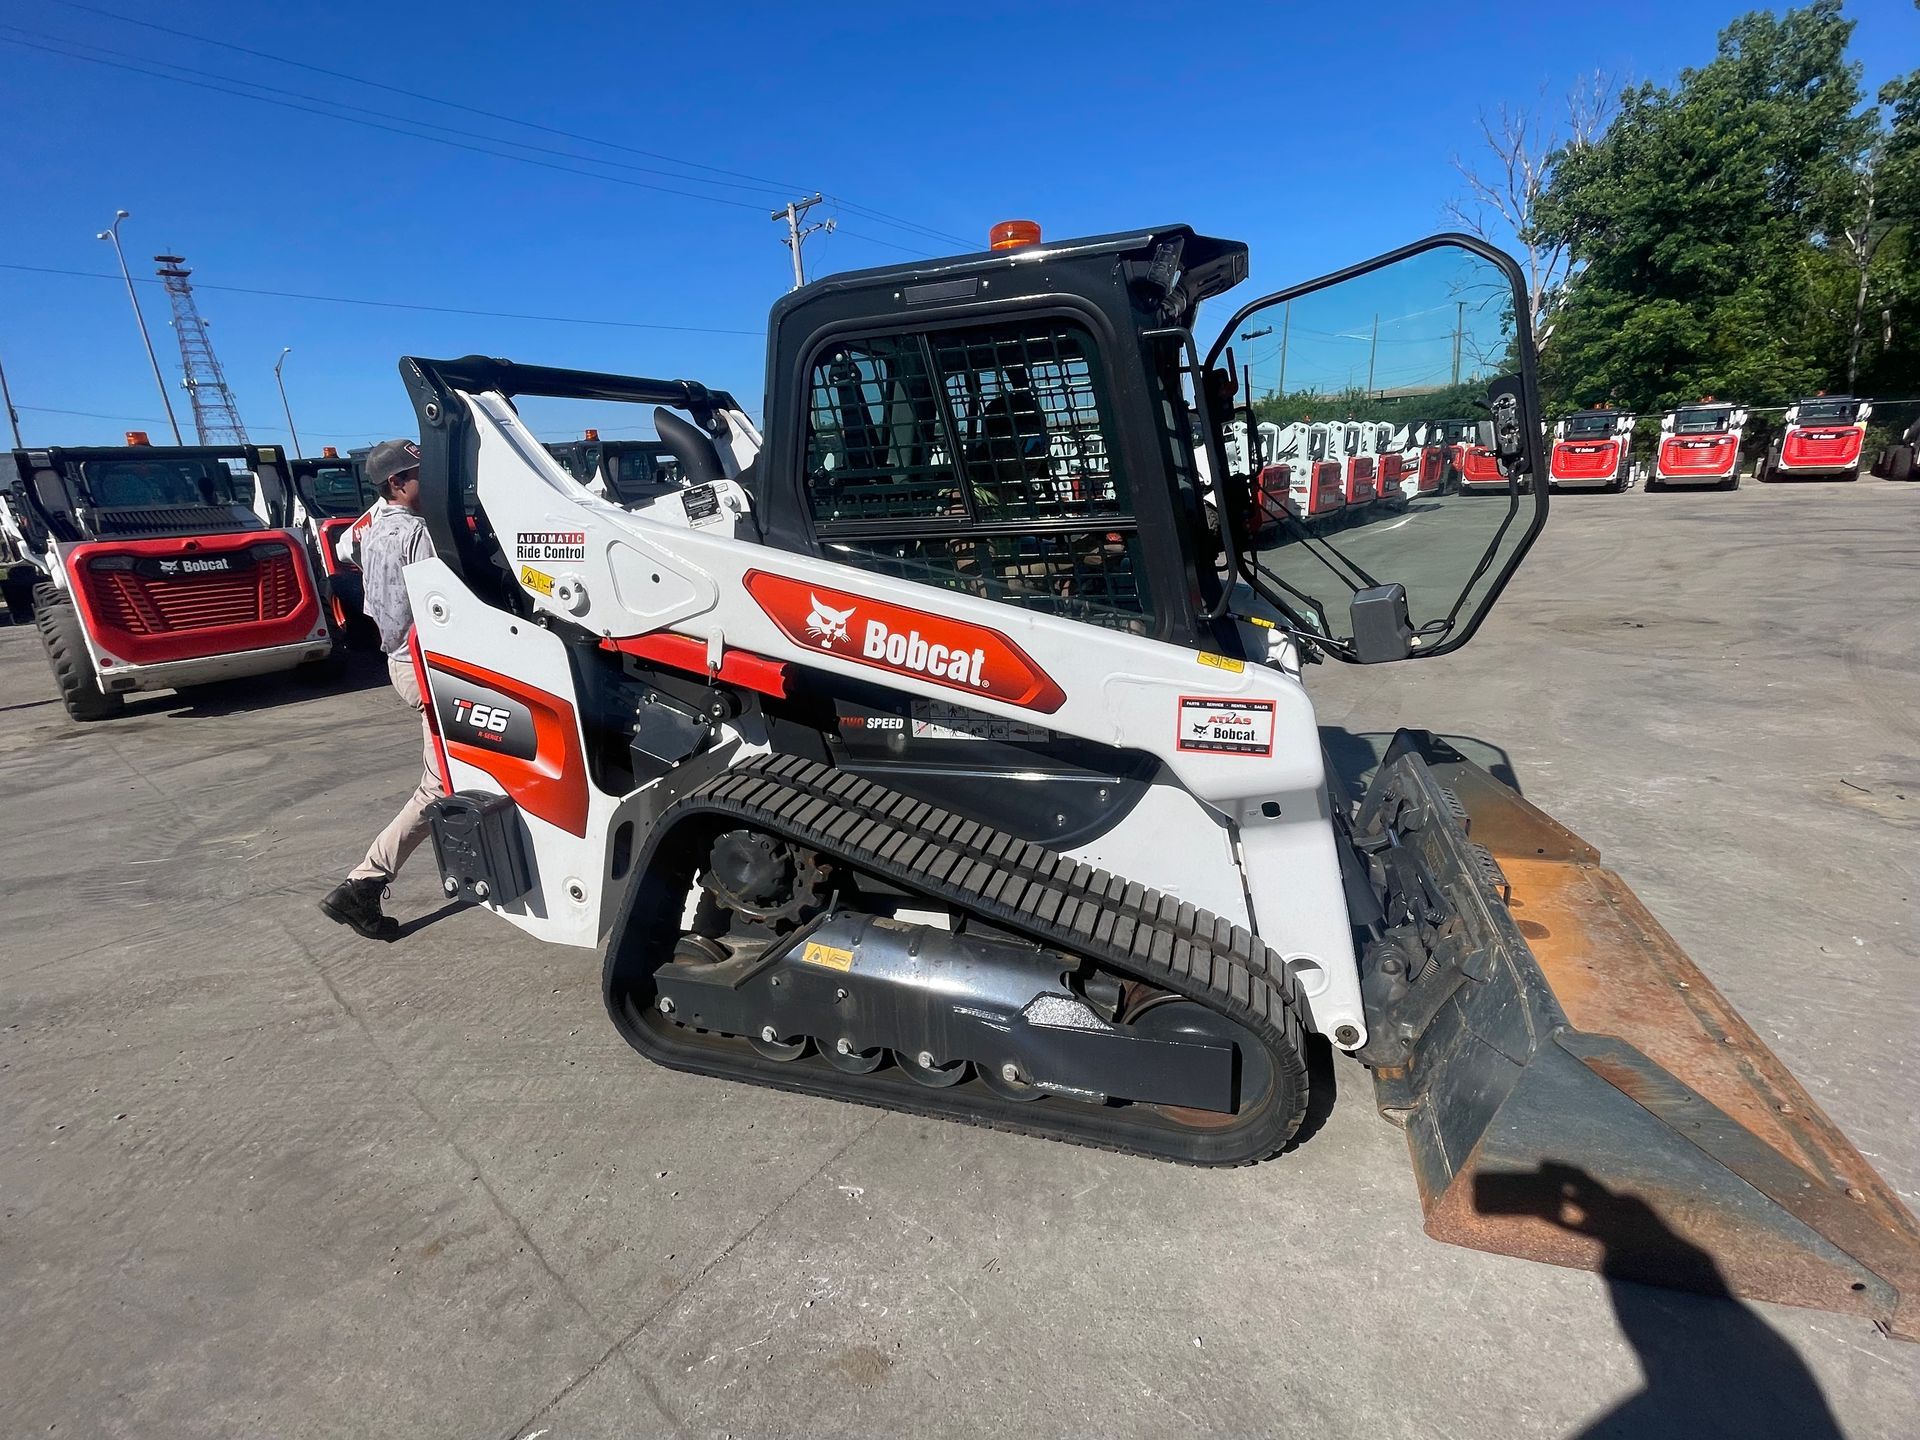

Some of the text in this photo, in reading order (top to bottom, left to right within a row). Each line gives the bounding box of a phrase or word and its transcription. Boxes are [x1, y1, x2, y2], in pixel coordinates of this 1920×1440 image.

[519, 534, 583, 543] AUTOMATIC
[517, 545, 585, 559] Ride Control
[182, 558, 229, 573] Bobcat
[863, 619, 986, 686] Bobcat
[453, 698, 511, 733] T66
[840, 716, 904, 729] TWO SPEED
[1207, 715, 1252, 725] ATLAS
[1213, 727, 1256, 741] Bobcat
